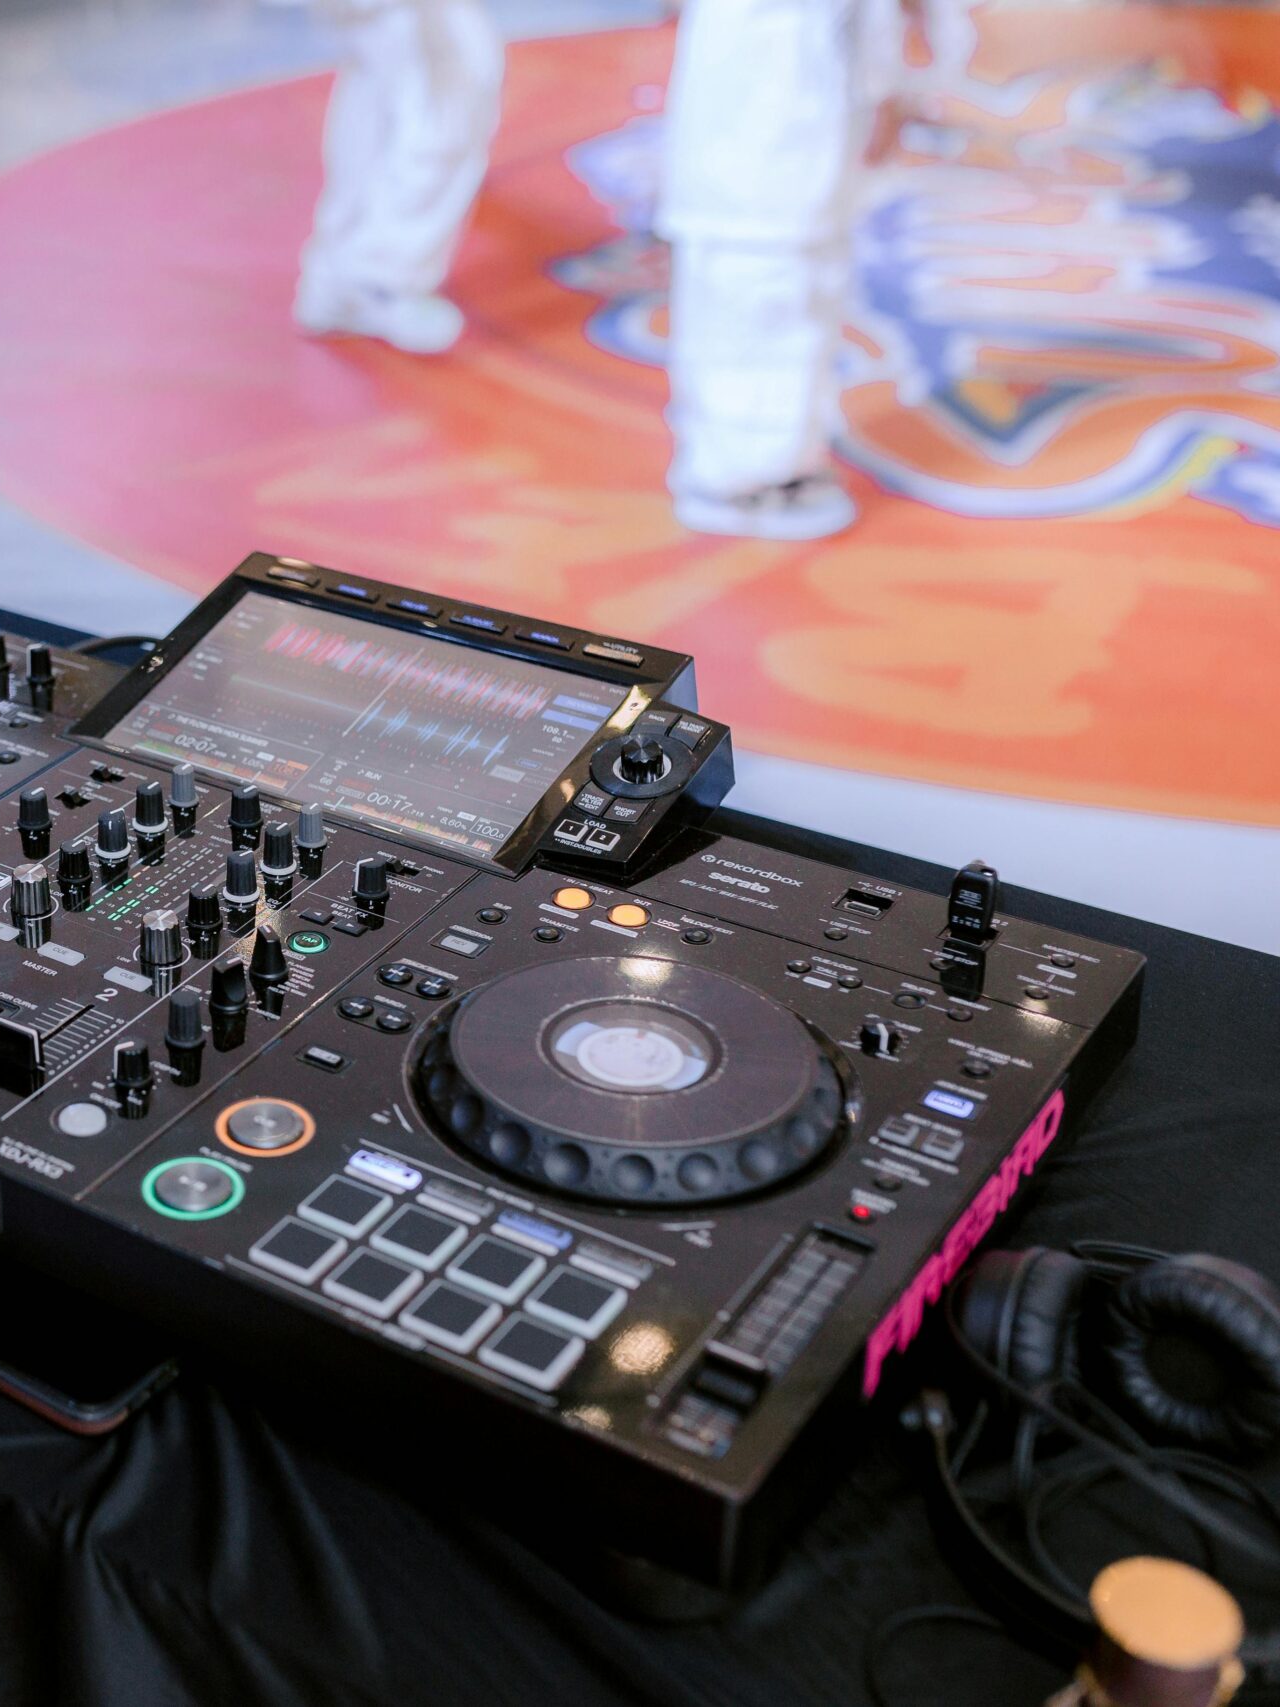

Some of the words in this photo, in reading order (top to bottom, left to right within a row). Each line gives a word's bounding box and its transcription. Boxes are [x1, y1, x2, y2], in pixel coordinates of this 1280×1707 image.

[364, 771, 383, 781] RUN
[584, 793, 604, 801] TRACK
[614, 805, 636, 814] SHORT
[583, 819, 607, 829] LOAD
[422, 865, 445, 875] PHONO
[716, 859, 804, 887] rekordbox
[708, 871, 771, 893] serato
[875, 885, 896, 894] USB
[633, 898, 653, 907] OUT
[330, 902, 356, 914] BEAT
[355, 910, 369, 919] FX
[331, 910, 353, 920] BEAT
[538, 916, 580, 933] QUANTIZE
[848, 925, 872, 935] STOP
[300, 935, 318, 943] TAP
[52, 946, 68, 954] CUE
[22, 960, 58, 977] MASTER
[119, 971, 136, 980] CUE
[94, 987, 119, 1002] 2
[12, 997, 39, 1010] CURVE
